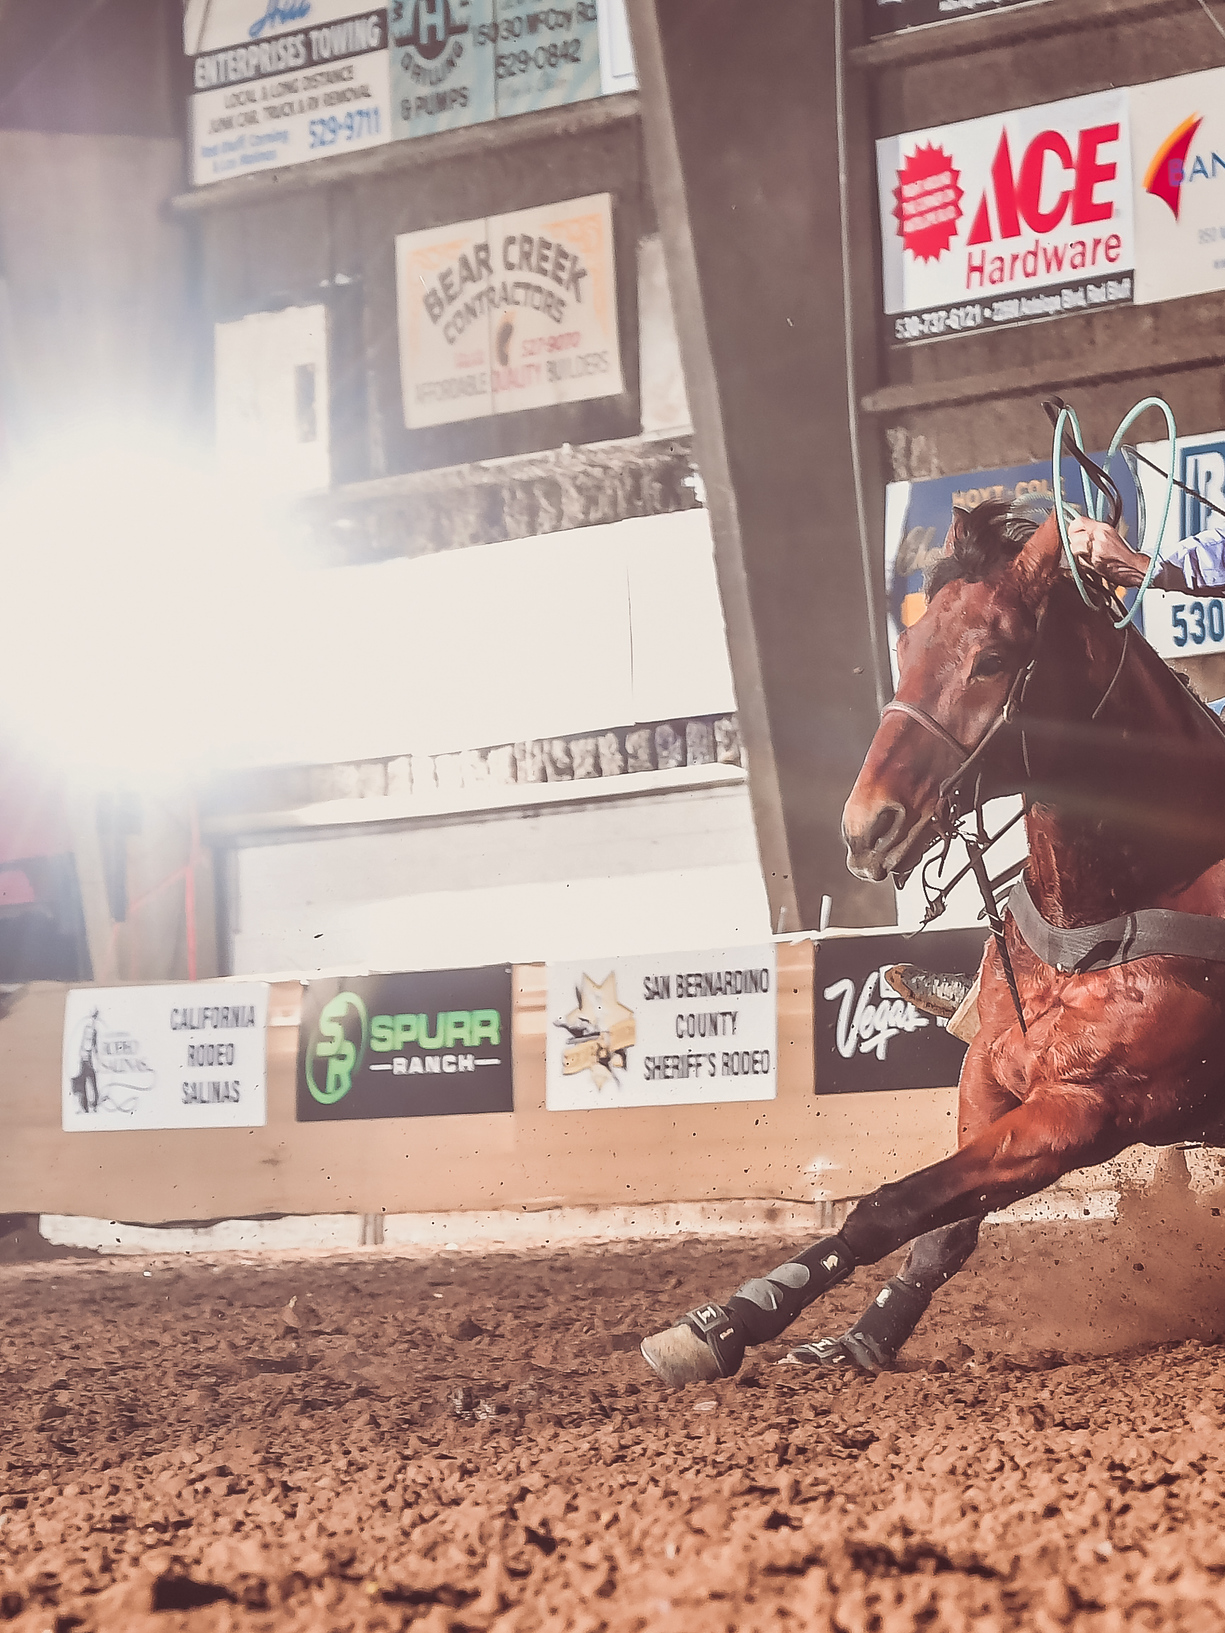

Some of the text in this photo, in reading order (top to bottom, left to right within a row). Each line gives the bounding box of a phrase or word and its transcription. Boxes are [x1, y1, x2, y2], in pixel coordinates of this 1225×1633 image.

[194, 34, 306, 89] ENTERPRISES
[309, 15, 382, 61] TOWING
[414, 86, 469, 118] PUMPS
[309, 107, 381, 150] 529-9711
[966, 122, 1120, 247] ACE
[966, 233, 1122, 290] Hardware
[423, 233, 588, 326] BEAR CREEK
[443, 280, 568, 346] CONTRACTORS
[643, 967, 769, 1001] SAN BERNARDINO
[170, 1005, 255, 1032] CALIFORNIA
[370, 1008, 500, 1053] SPURR
[676, 1010, 739, 1039] COUNTY
[187, 1043, 235, 1067] RODEO
[391, 1053, 476, 1076] RANCH
[643, 1049, 770, 1081] SHERIFF'S RODEO
[182, 1080, 241, 1105] SALINAS
